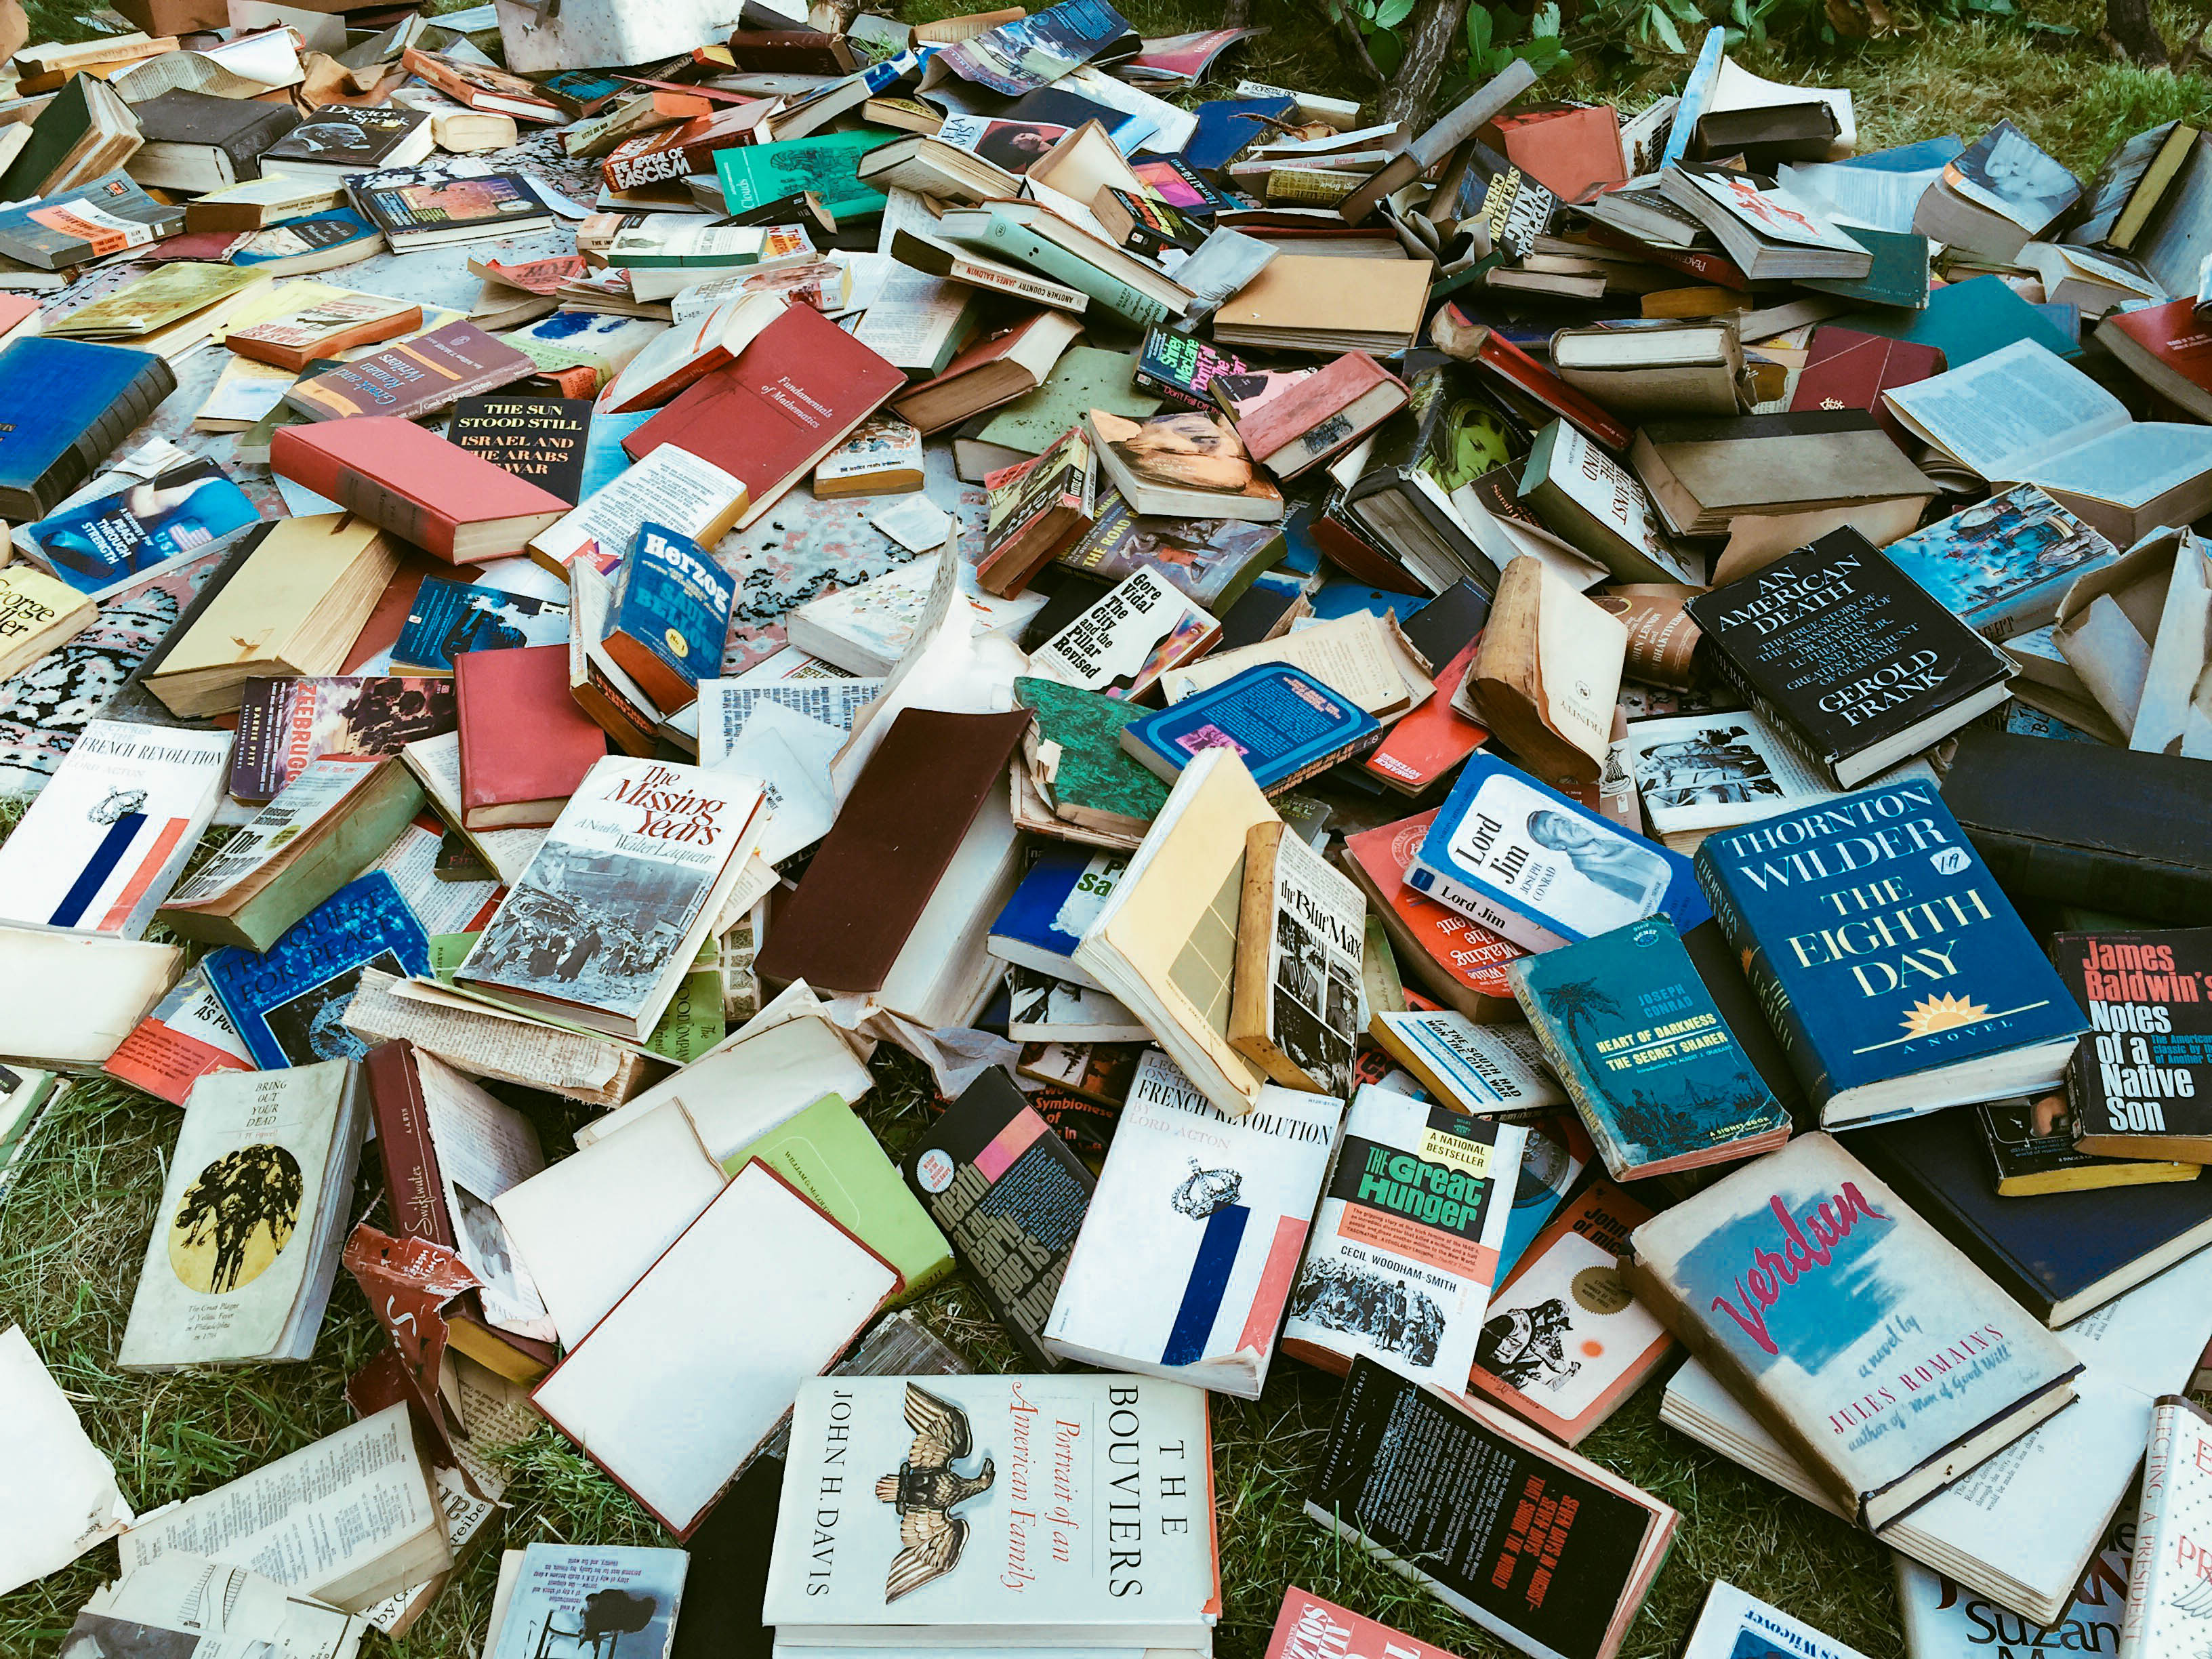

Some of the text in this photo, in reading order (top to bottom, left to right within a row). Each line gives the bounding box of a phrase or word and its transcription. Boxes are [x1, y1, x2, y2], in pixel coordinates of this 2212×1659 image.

[1252, 85, 1281, 96] BORSTAL
[326, 105, 397, 119] Doctor
[581, 129, 593, 139] LITTLE
[611, 146, 684, 174] THE APPEAL OF
[615, 157, 692, 190] FASCISM
[736, 178, 755, 209] Clouds
[1481, 172, 1506, 219] CREW
[1490, 165, 1521, 243] SKELETON
[1503, 182, 1538, 245] KING
[966, 266, 1074, 304] ANOTHER COUNTRY JAMES BALDWIN
[377, 354, 426, 383] Writers
[1159, 335, 1185, 369] Shirley
[329, 368, 397, 406] Greek and
[359, 362, 405, 390] Roman
[484, 404, 563, 415] THE SUN
[761, 384, 820, 430] of Mathematics
[777, 375, 834, 419] Fundamentals
[458, 418, 583, 431] STOOD STILL
[461, 436, 575, 449] ISRAEL AND
[504, 463, 548, 474] WAR
[81, 521, 120, 565] STRENGTH
[644, 533, 731, 614] Herzog
[1132, 573, 1162, 601] Gore
[1718, 553, 1862, 632] AMERICAN
[1757, 566, 1798, 595] AN
[659, 581, 707, 634] SAUL
[1104, 594, 1129, 619] The
[1120, 582, 1155, 615] Vidal
[1752, 579, 1856, 636] DEATH
[634, 586, 720, 664] BELLOW
[1079, 618, 1114, 649] and the
[1090, 606, 1118, 632] City
[1755, 594, 1891, 663] THE ASSASSINATION OF
[1052, 635, 1102, 680] Revised
[1065, 625, 1102, 659] Pillar
[1818, 637, 1877, 668] AND THE
[1818, 648, 1939, 714] GEROLD
[1840, 669, 1948, 728] FRANK
[79, 737, 226, 766] FRENCH REVOLUTION
[247, 706, 262, 766] BARRIE PITT
[640, 764, 681, 786] The
[600, 777, 728, 827] Missing
[632, 809, 722, 846] Years
[1454, 812, 1503, 867] Lord
[1721, 785, 1933, 859] THORNTON
[1488, 843, 1530, 885] Jim
[1736, 817, 1953, 893] WILDER
[1440, 885, 1507, 929] Lord Jim
[1820, 876, 1913, 917] THE
[1282, 881, 1362, 964] the Blue Max
[1784, 888, 1996, 969] EIGHTH
[1848, 939, 1963, 999] DAY
[2082, 940, 2175, 972] James
[258, 998, 271, 1008] The
[271, 989, 291, 1003] Story
[300, 978, 312, 989] the
[312, 965, 335, 979] Nobel
[336, 952, 362, 969] Awards
[1637, 984, 1686, 1006] JOSEPH
[2084, 969, 2212, 1003] Baldwin's
[1643, 996, 1694, 1018] CONRAD
[2089, 1000, 2173, 1033] Notes
[699, 1023, 716, 1040] The
[1595, 1012, 1717, 1054] HEART OF DARKNESS
[1903, 1019, 2013, 1054] A NOVEL
[2095, 1032, 2151, 1065] of a
[1425, 1019, 1512, 1099] WON THE CIVIL WAR
[1431, 1019, 1523, 1099] IF THE SOUTH HAD
[1605, 1031, 1729, 1071] THE SECRET SHARER
[2155, 1054, 2204, 1065] of Another
[254, 1079, 287, 1093] BRING
[257, 1091, 281, 1103] OUT
[2100, 1063, 2195, 1099] Native
[245, 1115, 277, 1128] DEAD
[250, 1103, 279, 1116] YOUR
[1036, 1098, 1114, 1120] Symbionese
[1046, 1111, 1062, 1124] of
[1132, 1101, 1152, 1115] BY
[2106, 1096, 2167, 1132] Son
[1065, 1126, 1078, 1140] in
[1429, 1132, 1485, 1156] A NATIONAL
[1426, 1142, 1485, 1168] BESTSELLER
[1364, 1146, 1486, 1207] THE Great
[930, 1161, 993, 1232] death
[1357, 1172, 1477, 1231] Hunger
[1340, 1245, 1457, 1292] CECIL WOODHAM-SMITH
[1711, 1182, 1893, 1355] Verdun
[188, 1305, 200, 1313] The
[219, 1302, 240, 1311] Plague
[1858, 1313, 1924, 1378] a novel by
[1828, 1323, 2004, 1435] JULES ROMAINS
[806, 1389, 855, 1597] JOHN H. DAVIS
[1000, 1380, 1041, 1595] American Family
[1107, 1385, 1143, 1599] BOUVIERS
[1158, 1439, 1189, 1537] THE
[1491, 1474, 1547, 1591] THAT SHOOK THE WORLD
[1523, 1496, 1559, 1557] SEVEN DAYS
[2123, 1405, 2175, 1644] ELECTING A PRESIDENT
